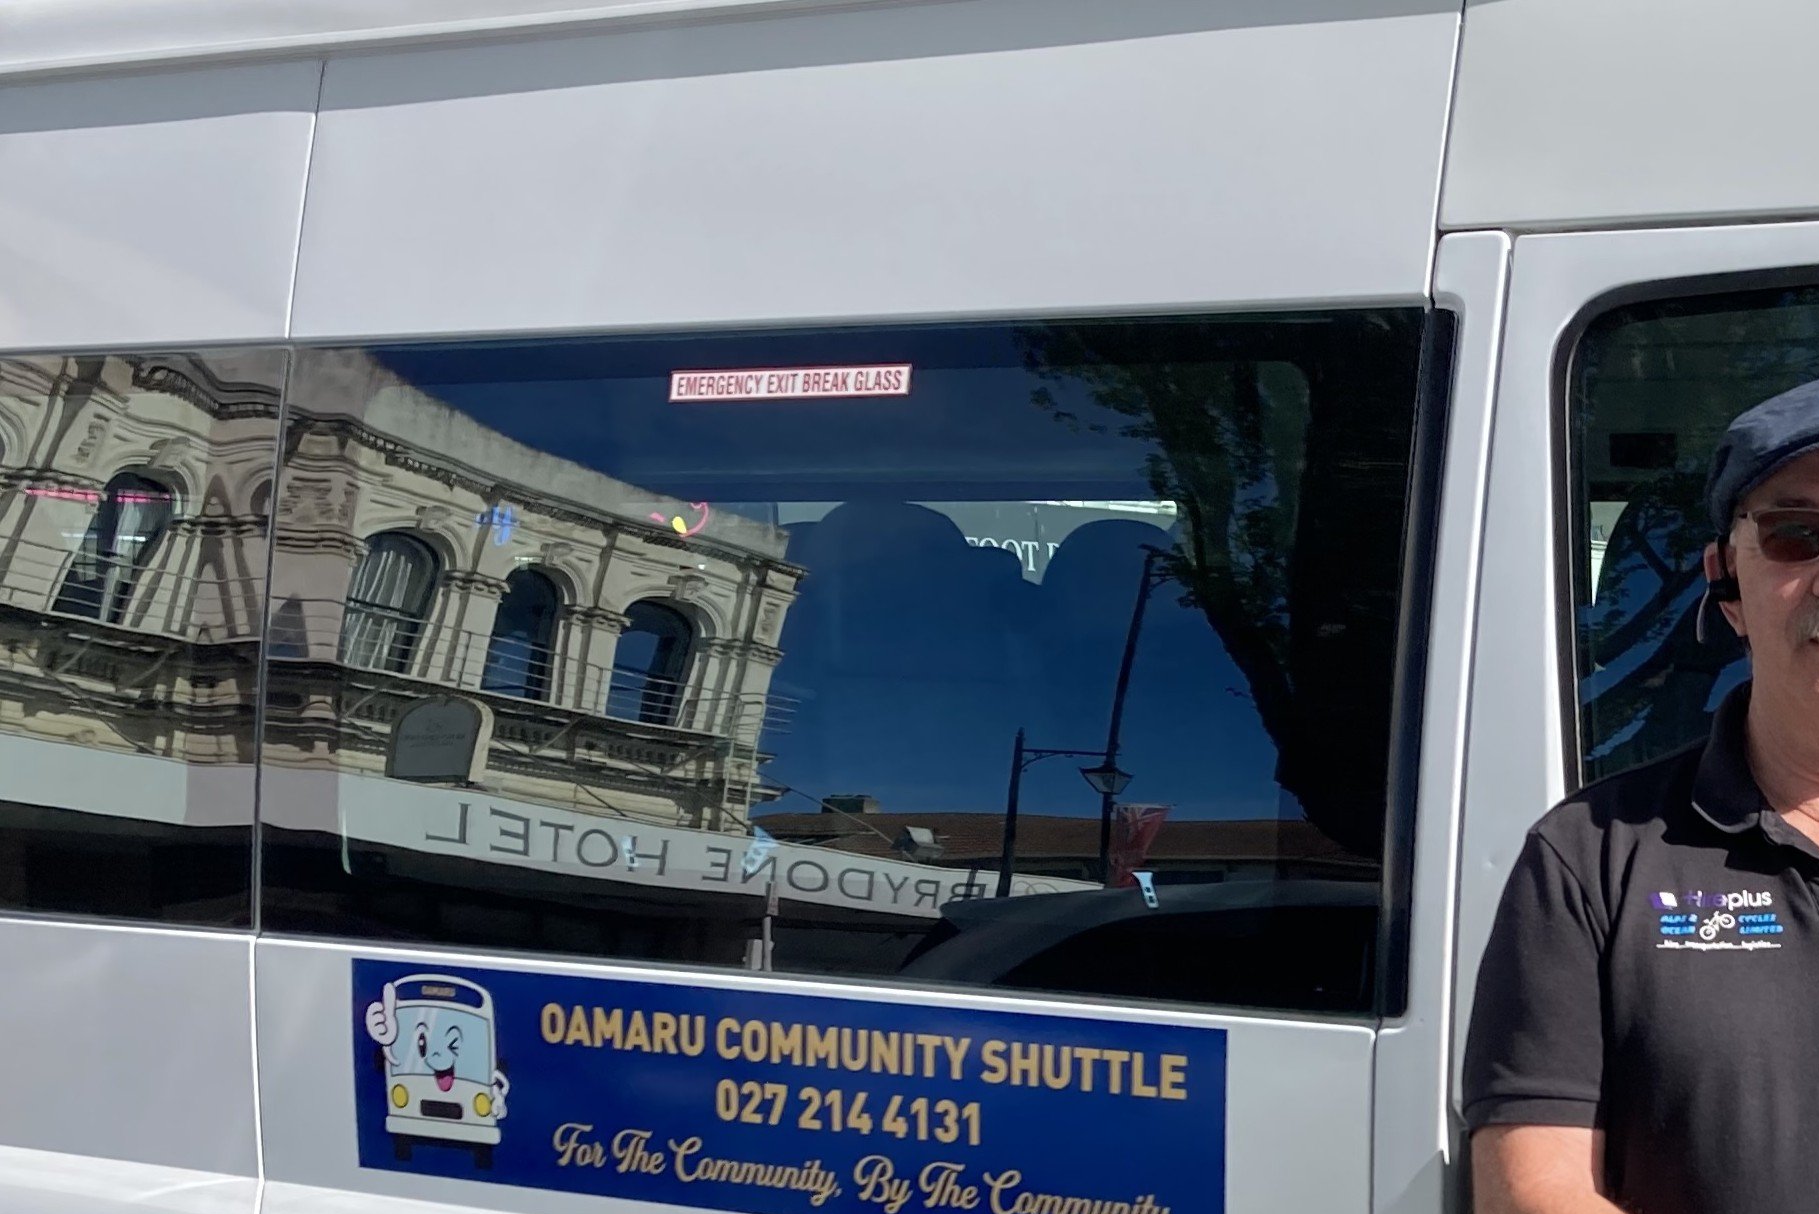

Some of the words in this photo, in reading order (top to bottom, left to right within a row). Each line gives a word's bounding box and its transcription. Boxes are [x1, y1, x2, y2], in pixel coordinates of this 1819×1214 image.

[676, 374, 764, 397] EMERGENCY
[767, 373, 798, 395] EXIT
[802, 371, 849, 394] BREAK
[854, 369, 902, 392] GLASS
[541, 1002, 706, 1057] OAMARU
[715, 1017, 972, 1081] COMMUNITY
[980, 1039, 1188, 1100] SHUTTLE
[715, 1079, 788, 1126] 027
[798, 1086, 873, 1135] 214
[881, 1095, 981, 1146] 4131
[553, 1122, 607, 1168] For
[612, 1129, 666, 1174] The
[667, 1136, 843, 1206] Community,
[853, 1154, 913, 1214] By
[918, 1161, 981, 1210] The
